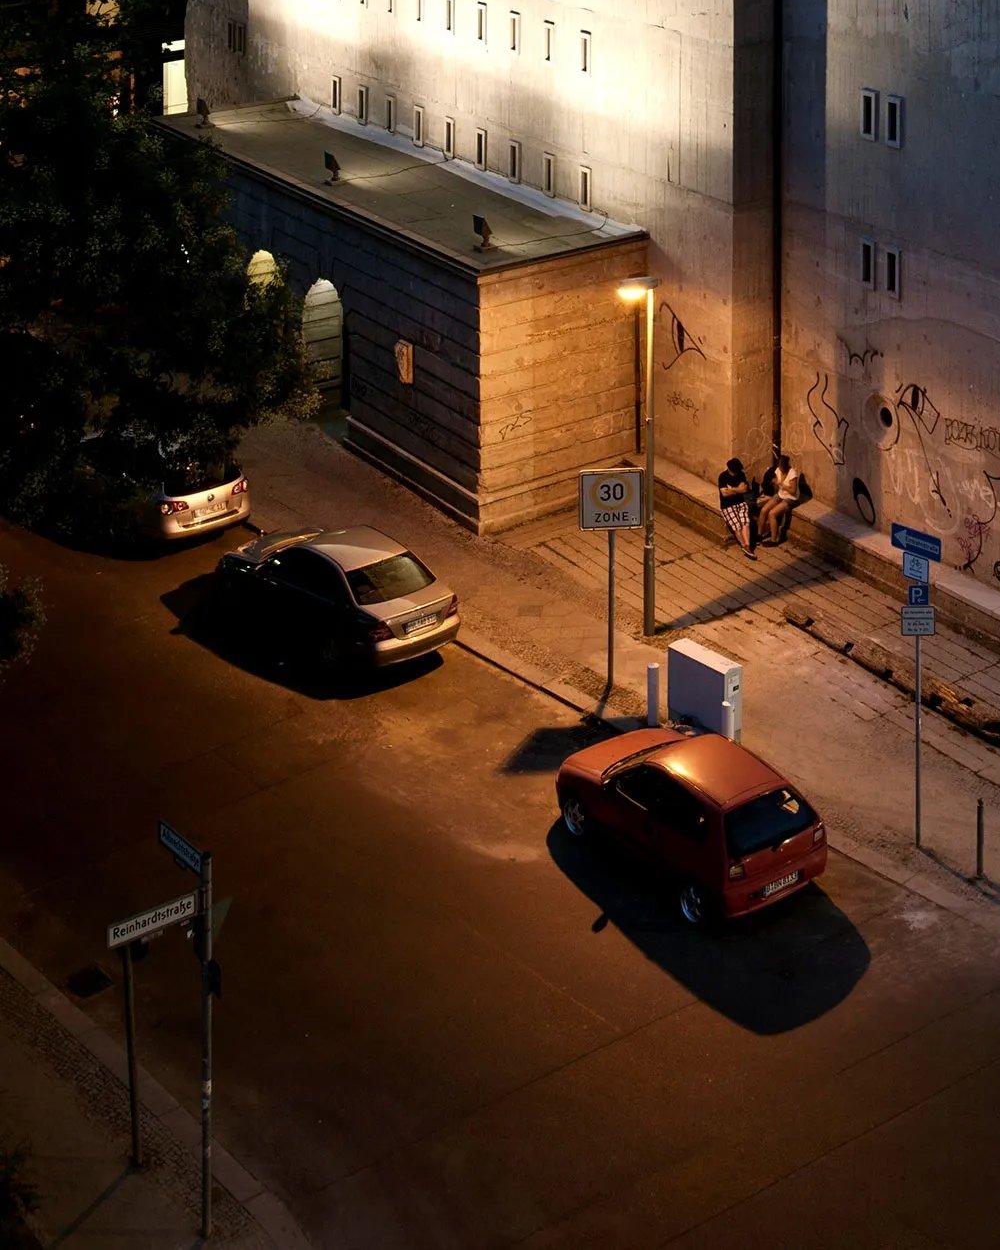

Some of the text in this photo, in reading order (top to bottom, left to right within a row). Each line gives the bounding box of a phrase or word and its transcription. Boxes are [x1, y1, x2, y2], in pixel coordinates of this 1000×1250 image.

[600, 483, 624, 502] 30
[595, 511, 629, 523] ZONE
[912, 588, 923, 604] P
[112, 900, 192, 940] Reinhardtstraße
